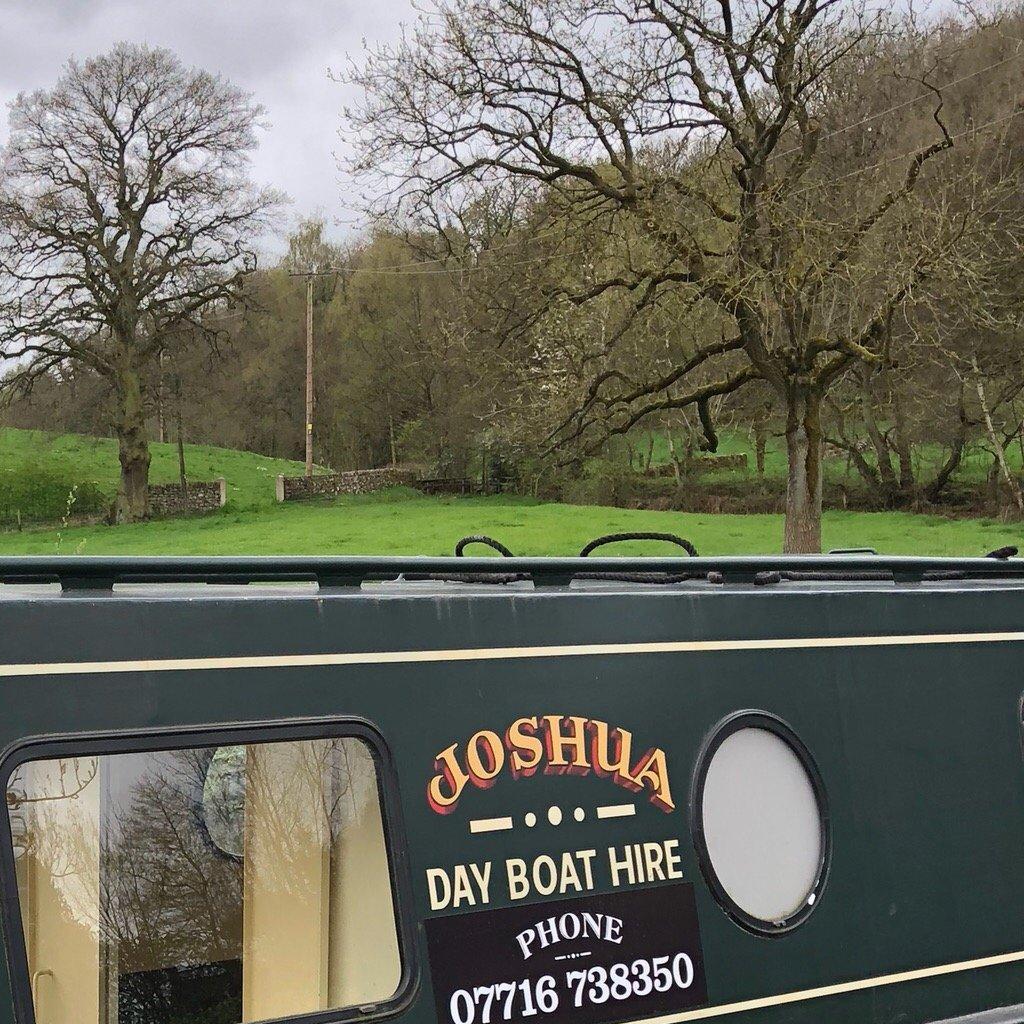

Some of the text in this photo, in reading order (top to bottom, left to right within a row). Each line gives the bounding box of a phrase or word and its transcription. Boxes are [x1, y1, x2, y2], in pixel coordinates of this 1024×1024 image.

[426, 715, 675, 815] JOSHUA
[426, 839, 683, 911] DAY BOAT HIRE
[515, 911, 624, 960] PHONE
[566, 952, 694, 1008] 738350
